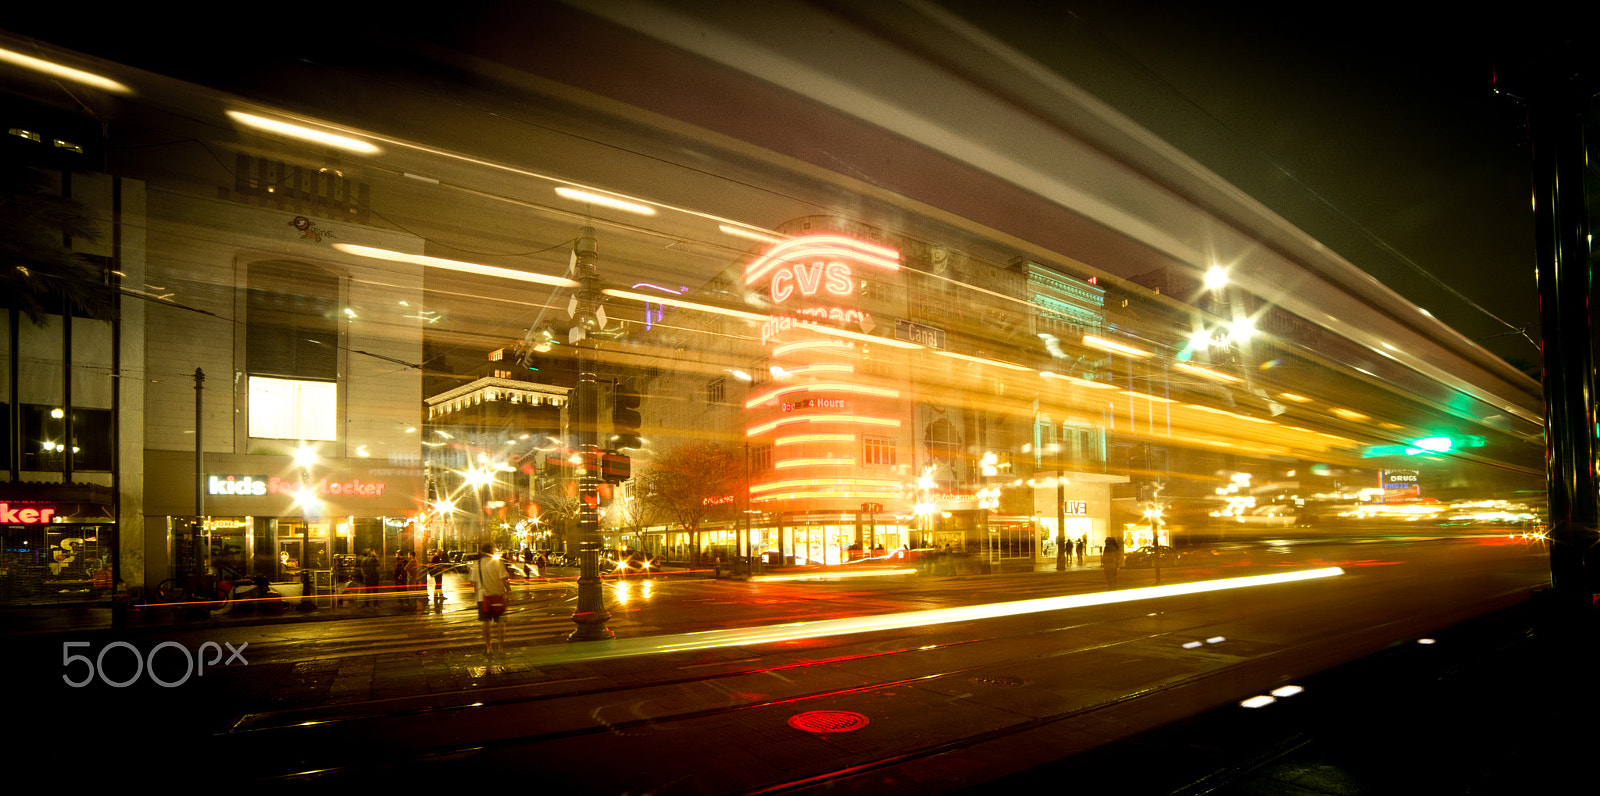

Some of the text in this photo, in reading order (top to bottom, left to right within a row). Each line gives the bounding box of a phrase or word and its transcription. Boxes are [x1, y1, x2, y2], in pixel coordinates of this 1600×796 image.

[771, 262, 854, 304] CVS
[908, 323, 938, 347] Canal
[817, 398, 845, 408] Hours
[209, 475, 385, 496] kids Foo Locker
